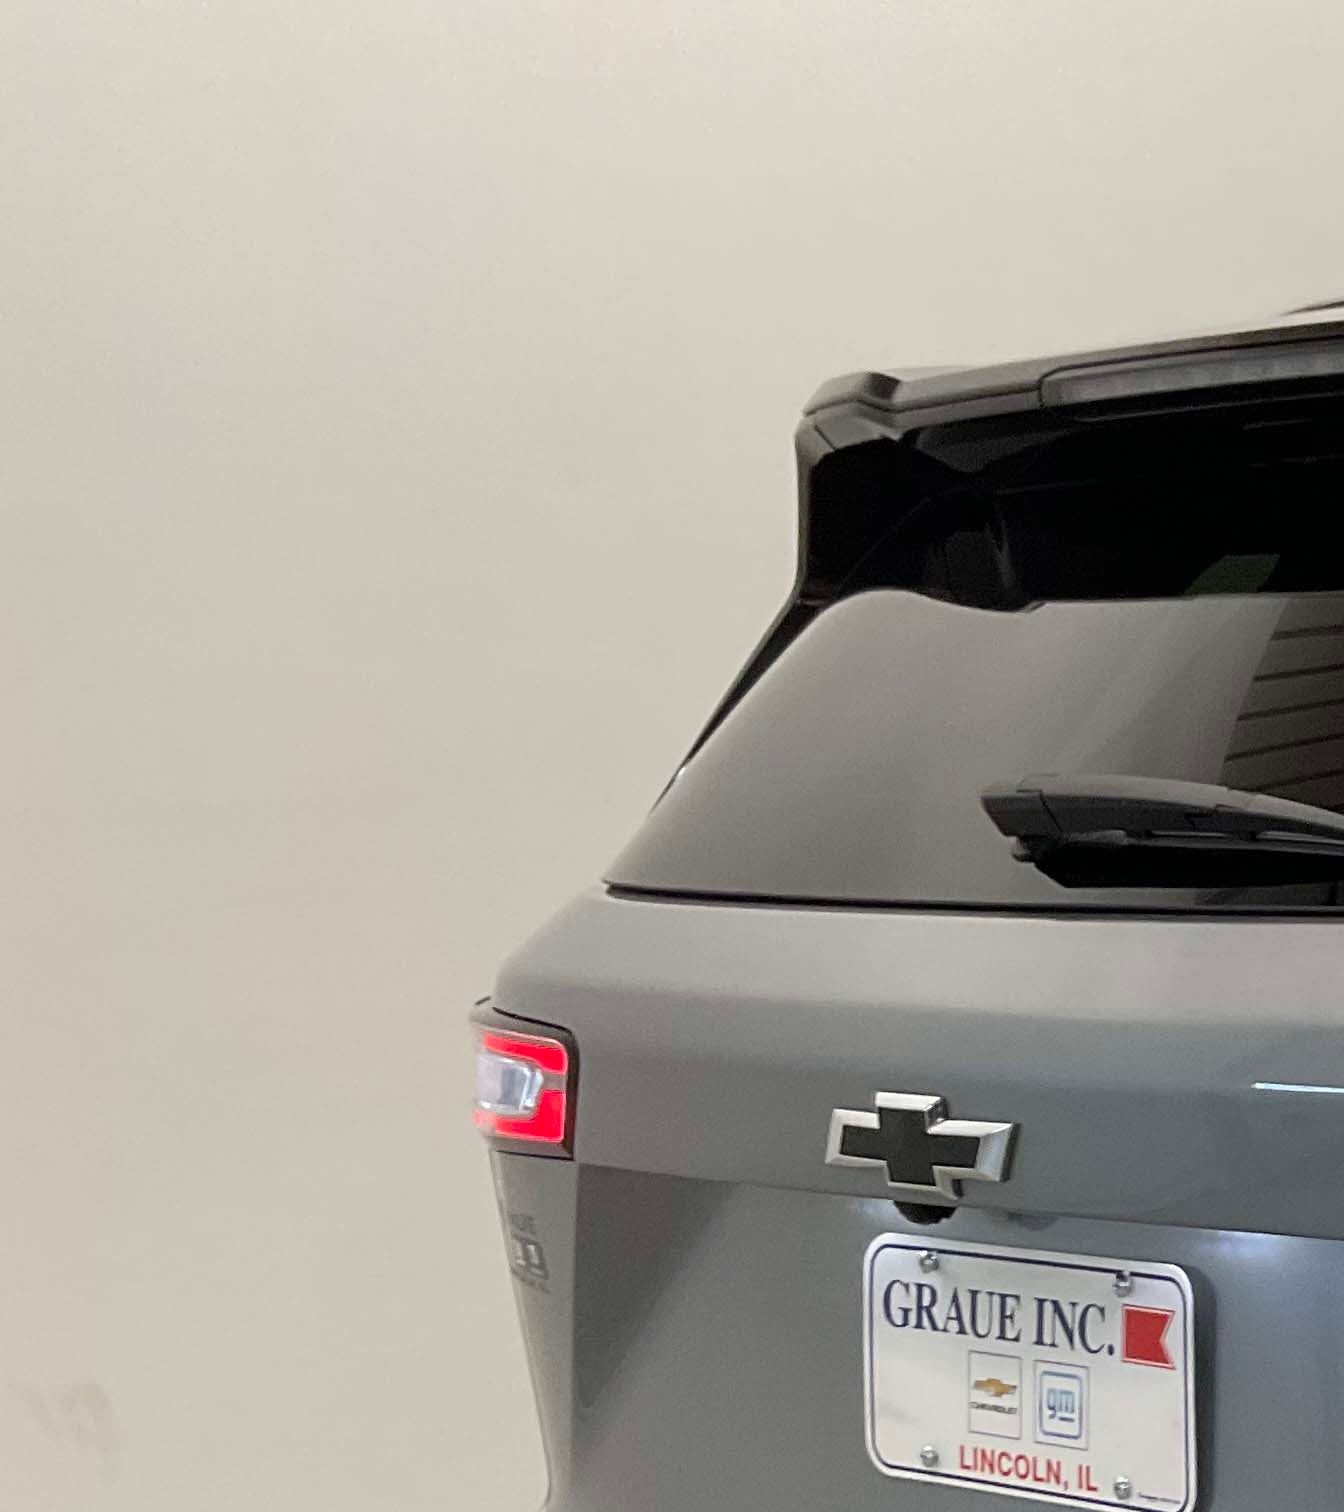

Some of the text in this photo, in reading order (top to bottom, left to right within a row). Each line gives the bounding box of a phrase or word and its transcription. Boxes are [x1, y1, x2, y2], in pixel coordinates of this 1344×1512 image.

[883, 1279, 1115, 1357] GRAUE INC.
[958, 1444, 1099, 1493] LINCOLN, IL
